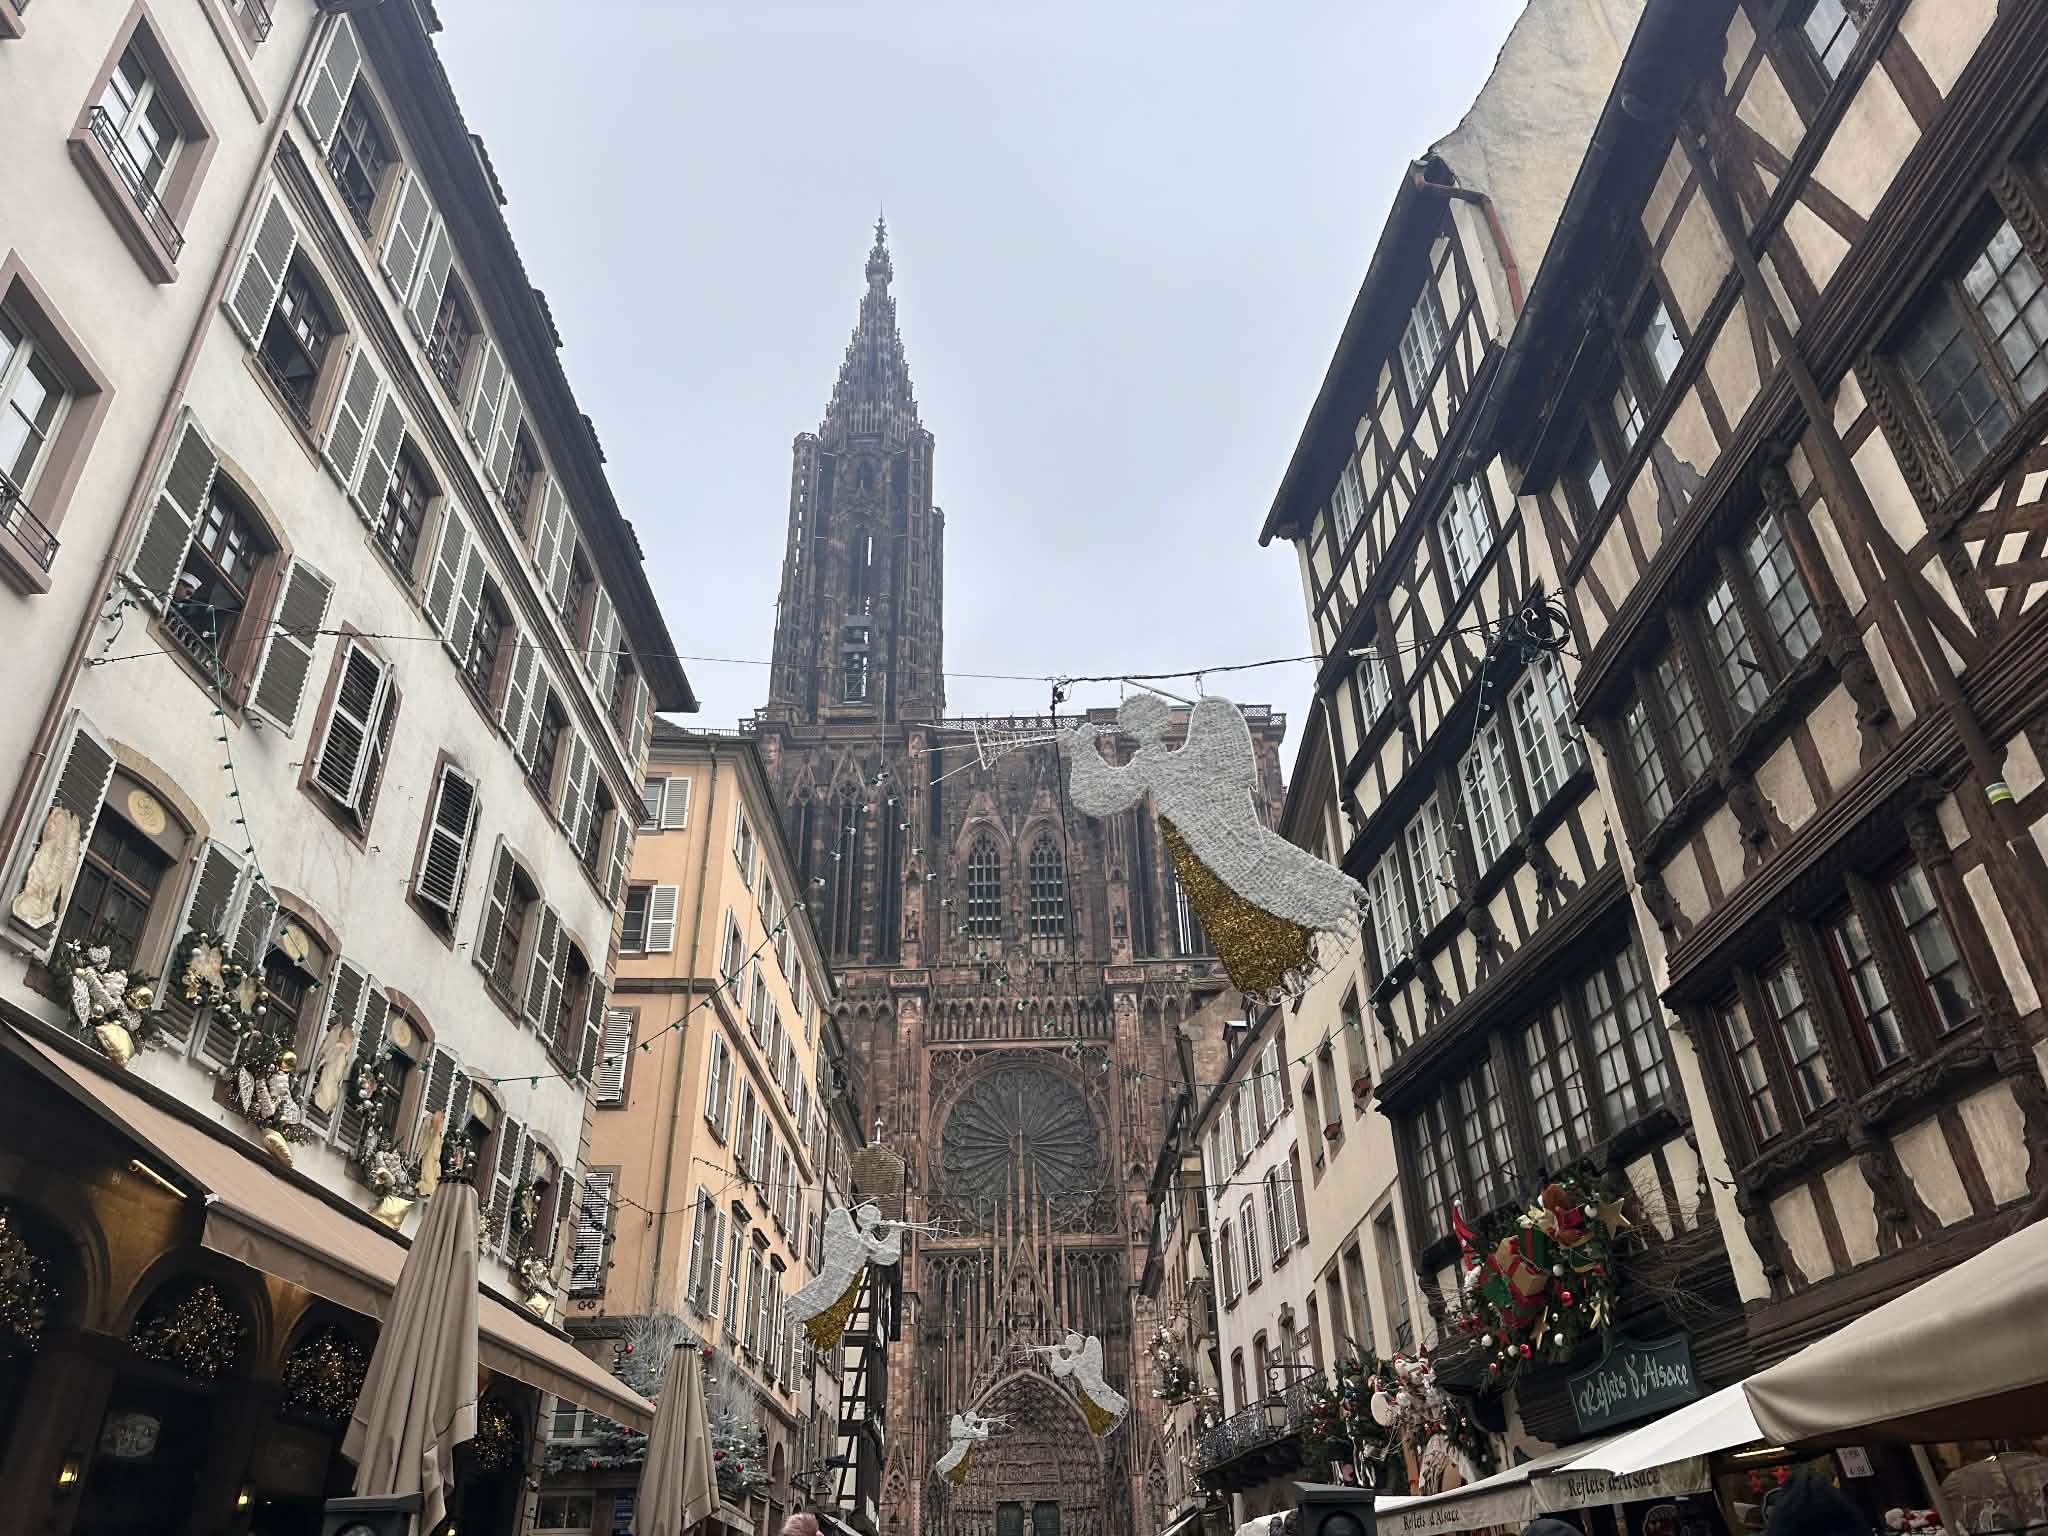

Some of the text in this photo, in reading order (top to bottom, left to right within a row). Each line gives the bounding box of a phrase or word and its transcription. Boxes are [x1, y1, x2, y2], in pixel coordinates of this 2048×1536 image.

[1580, 1371, 1627, 1417] Reflets
[1568, 1473, 1605, 1504] Reflets
[1404, 1512, 1426, 1530] Reflets
